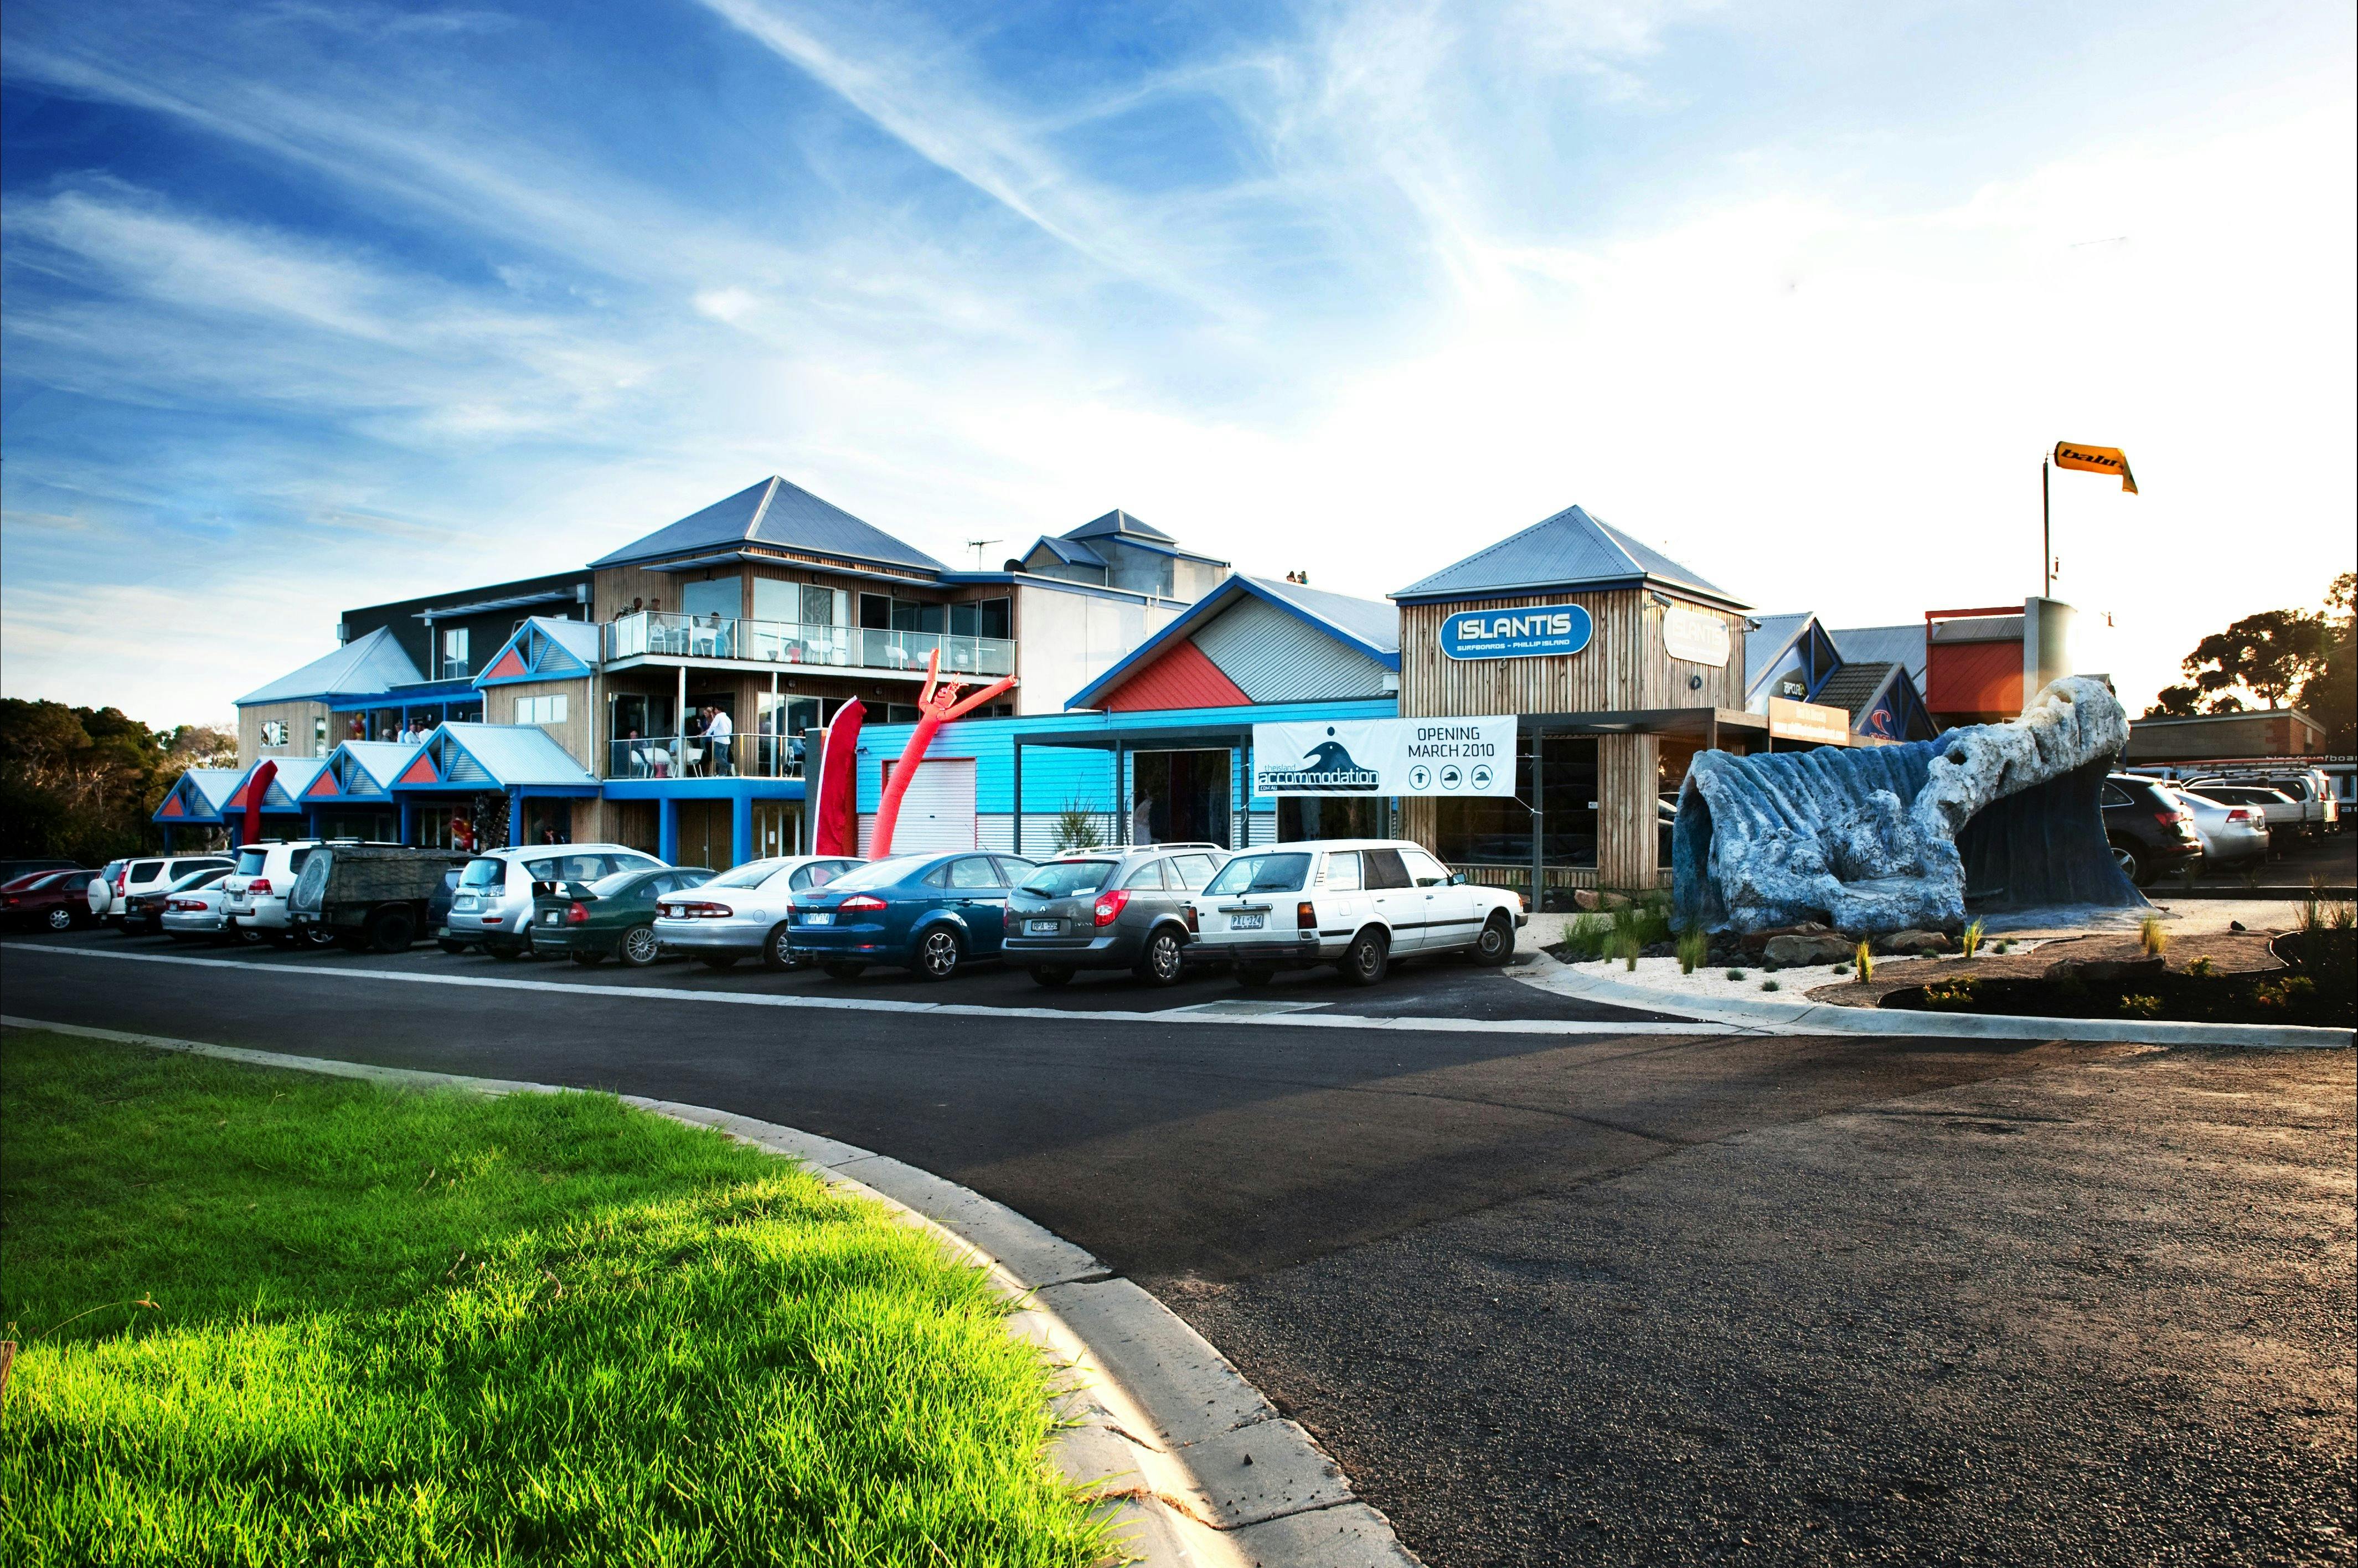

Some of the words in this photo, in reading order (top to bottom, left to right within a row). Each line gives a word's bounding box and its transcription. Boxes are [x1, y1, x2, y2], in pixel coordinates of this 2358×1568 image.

[1457, 613, 1571, 640] ISLANTIS
[1417, 727, 1479, 741] OPENING
[1408, 744, 1459, 757] MARCH
[1463, 744, 1494, 757] 2010
[1259, 767, 1379, 785] accommodation
